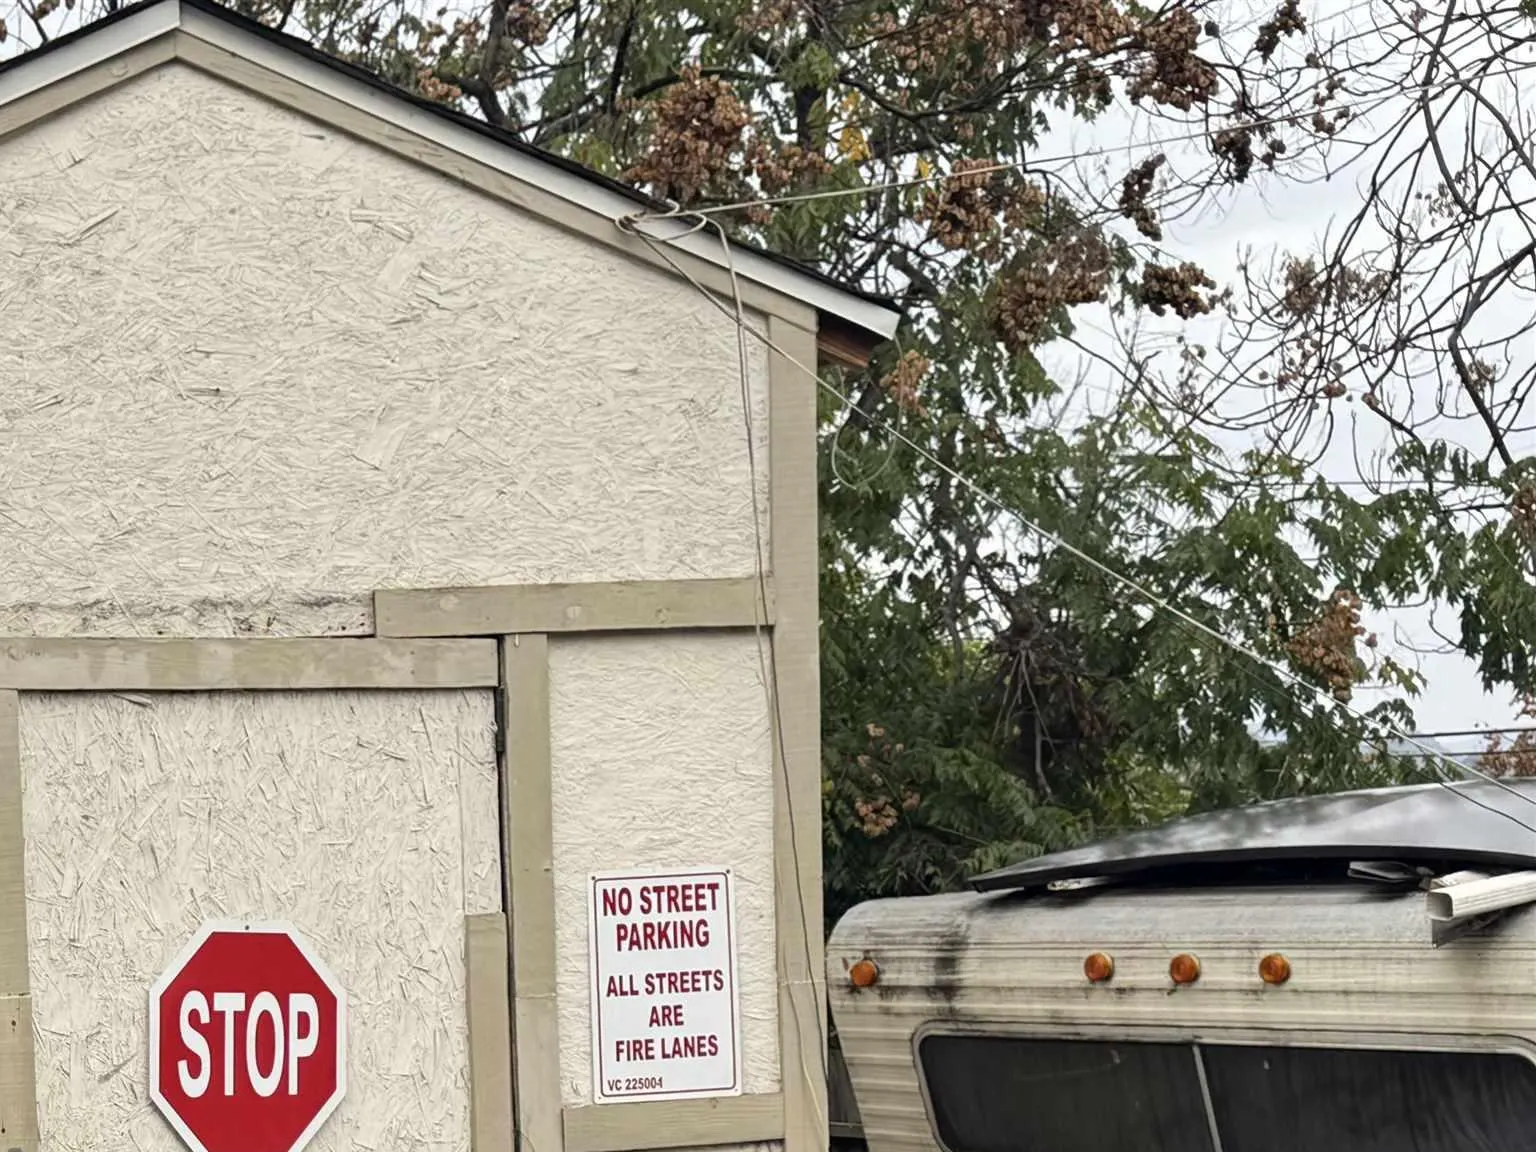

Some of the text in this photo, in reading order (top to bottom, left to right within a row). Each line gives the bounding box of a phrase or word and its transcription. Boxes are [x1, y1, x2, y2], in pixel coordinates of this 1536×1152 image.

[602, 882, 720, 916] NO STREET
[616, 918, 710, 952] PARKING
[606, 969, 724, 997] ALL STREETS
[649, 1004, 684, 1028] ARE
[177, 990, 320, 1098] STOP
[615, 1034, 719, 1062] FIRE LANES
[607, 1079, 622, 1091] VC
